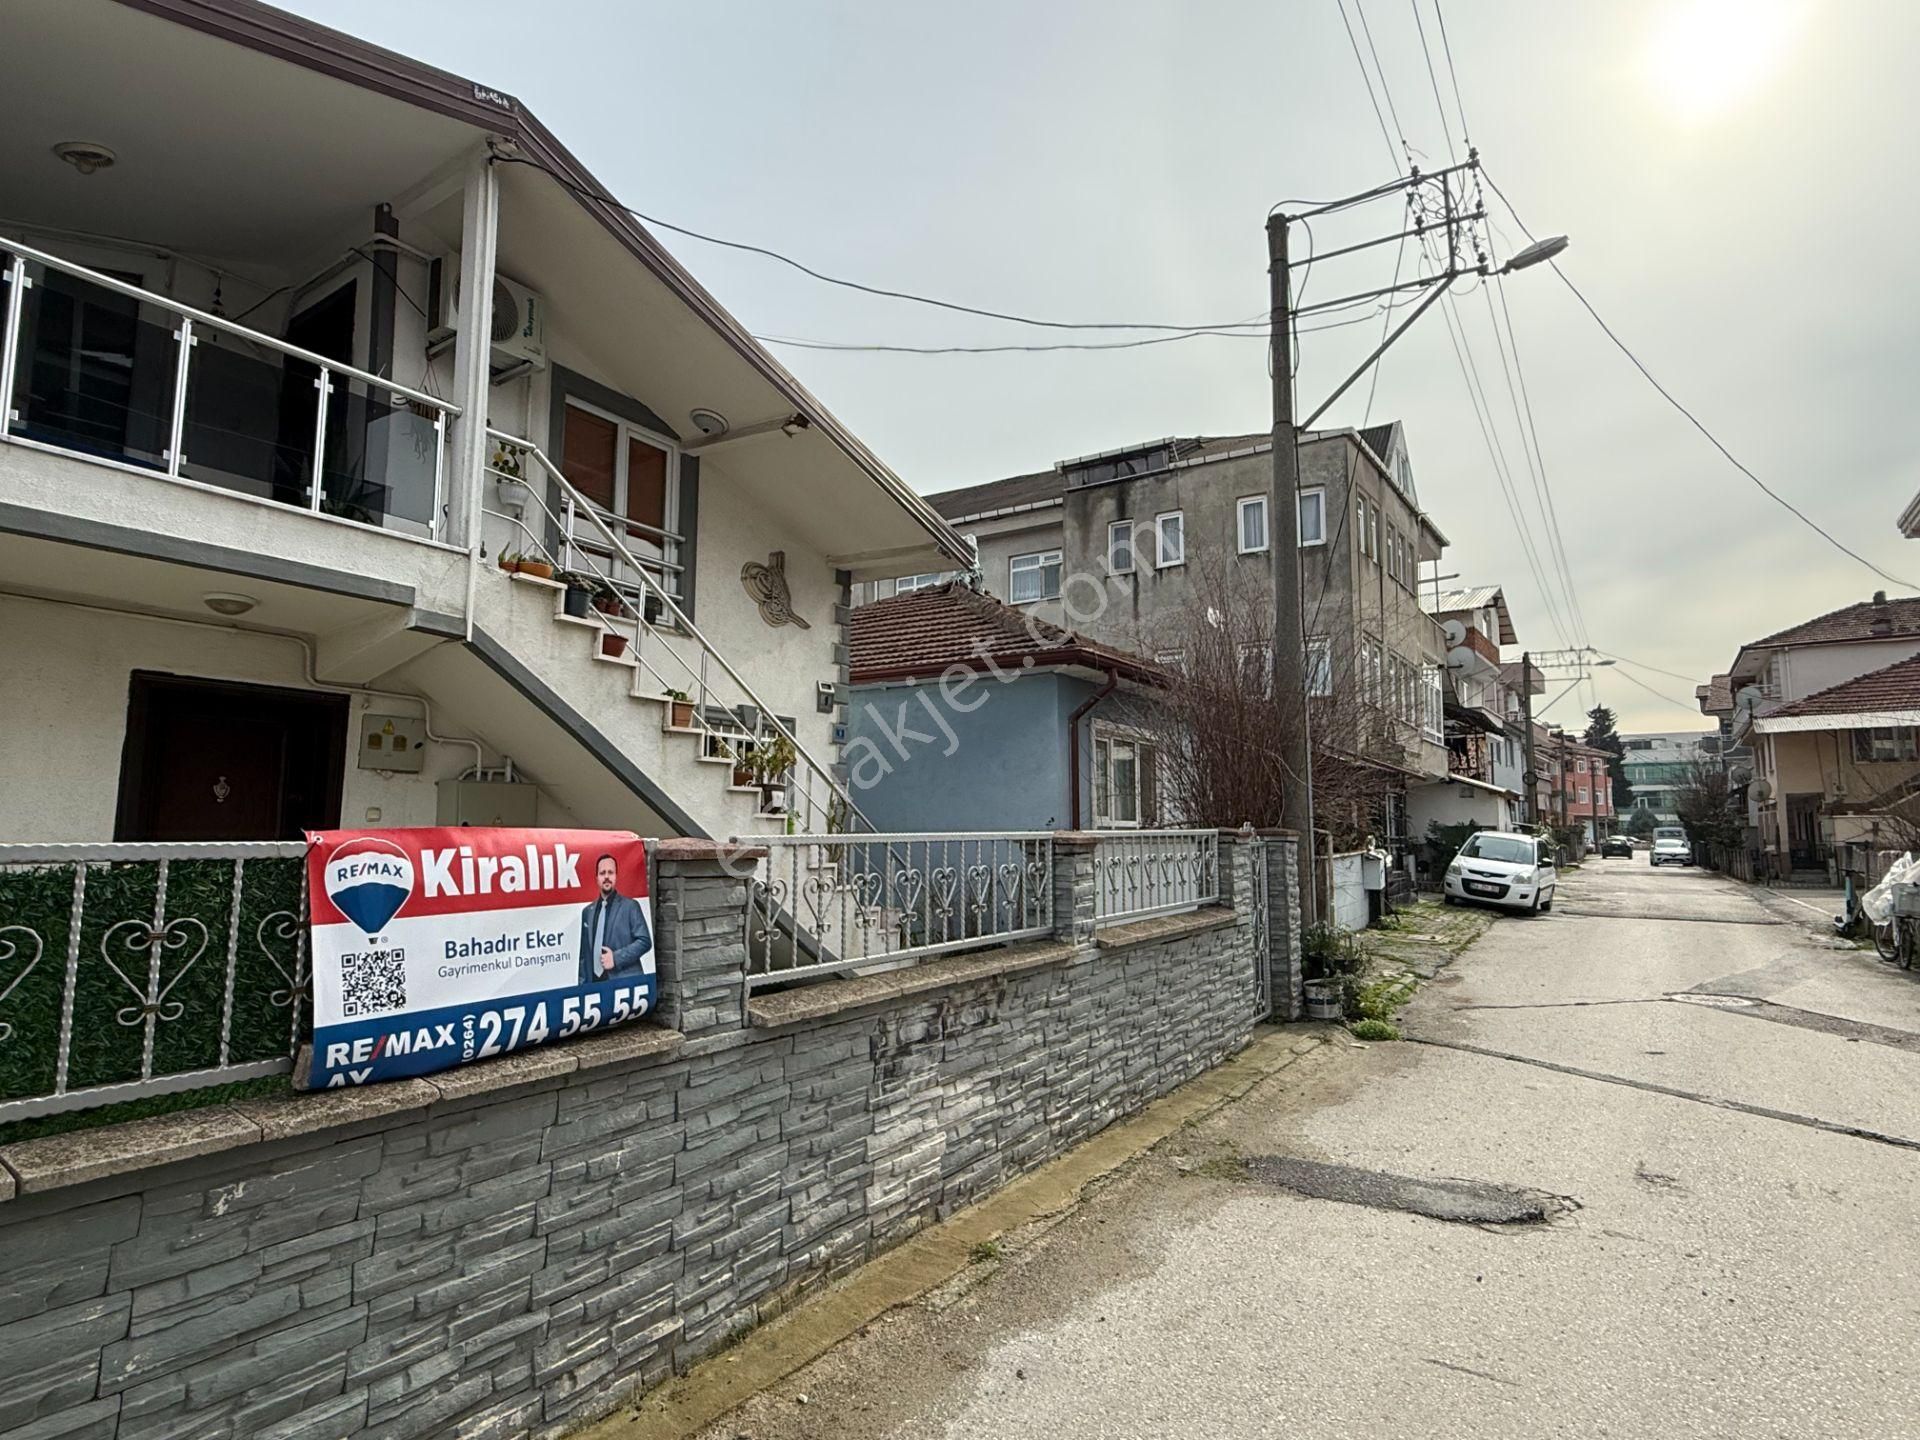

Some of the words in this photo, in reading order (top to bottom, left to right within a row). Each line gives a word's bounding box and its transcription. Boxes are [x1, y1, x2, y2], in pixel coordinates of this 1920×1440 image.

[337, 862, 404, 882] RE/MAX
[420, 843, 582, 898] Kiralık
[444, 933, 520, 959] Bahadır
[525, 930, 565, 949] Eker
[438, 957, 512, 978] Gayrimenkul
[515, 951, 571, 967] Danışmanı
[461, 1014, 477, 1062] (0264)
[477, 1001, 550, 1059] 274
[559, 993, 601, 1037] 55
[609, 984, 649, 1025] 55
[325, 1023, 456, 1068] RE/MAX
